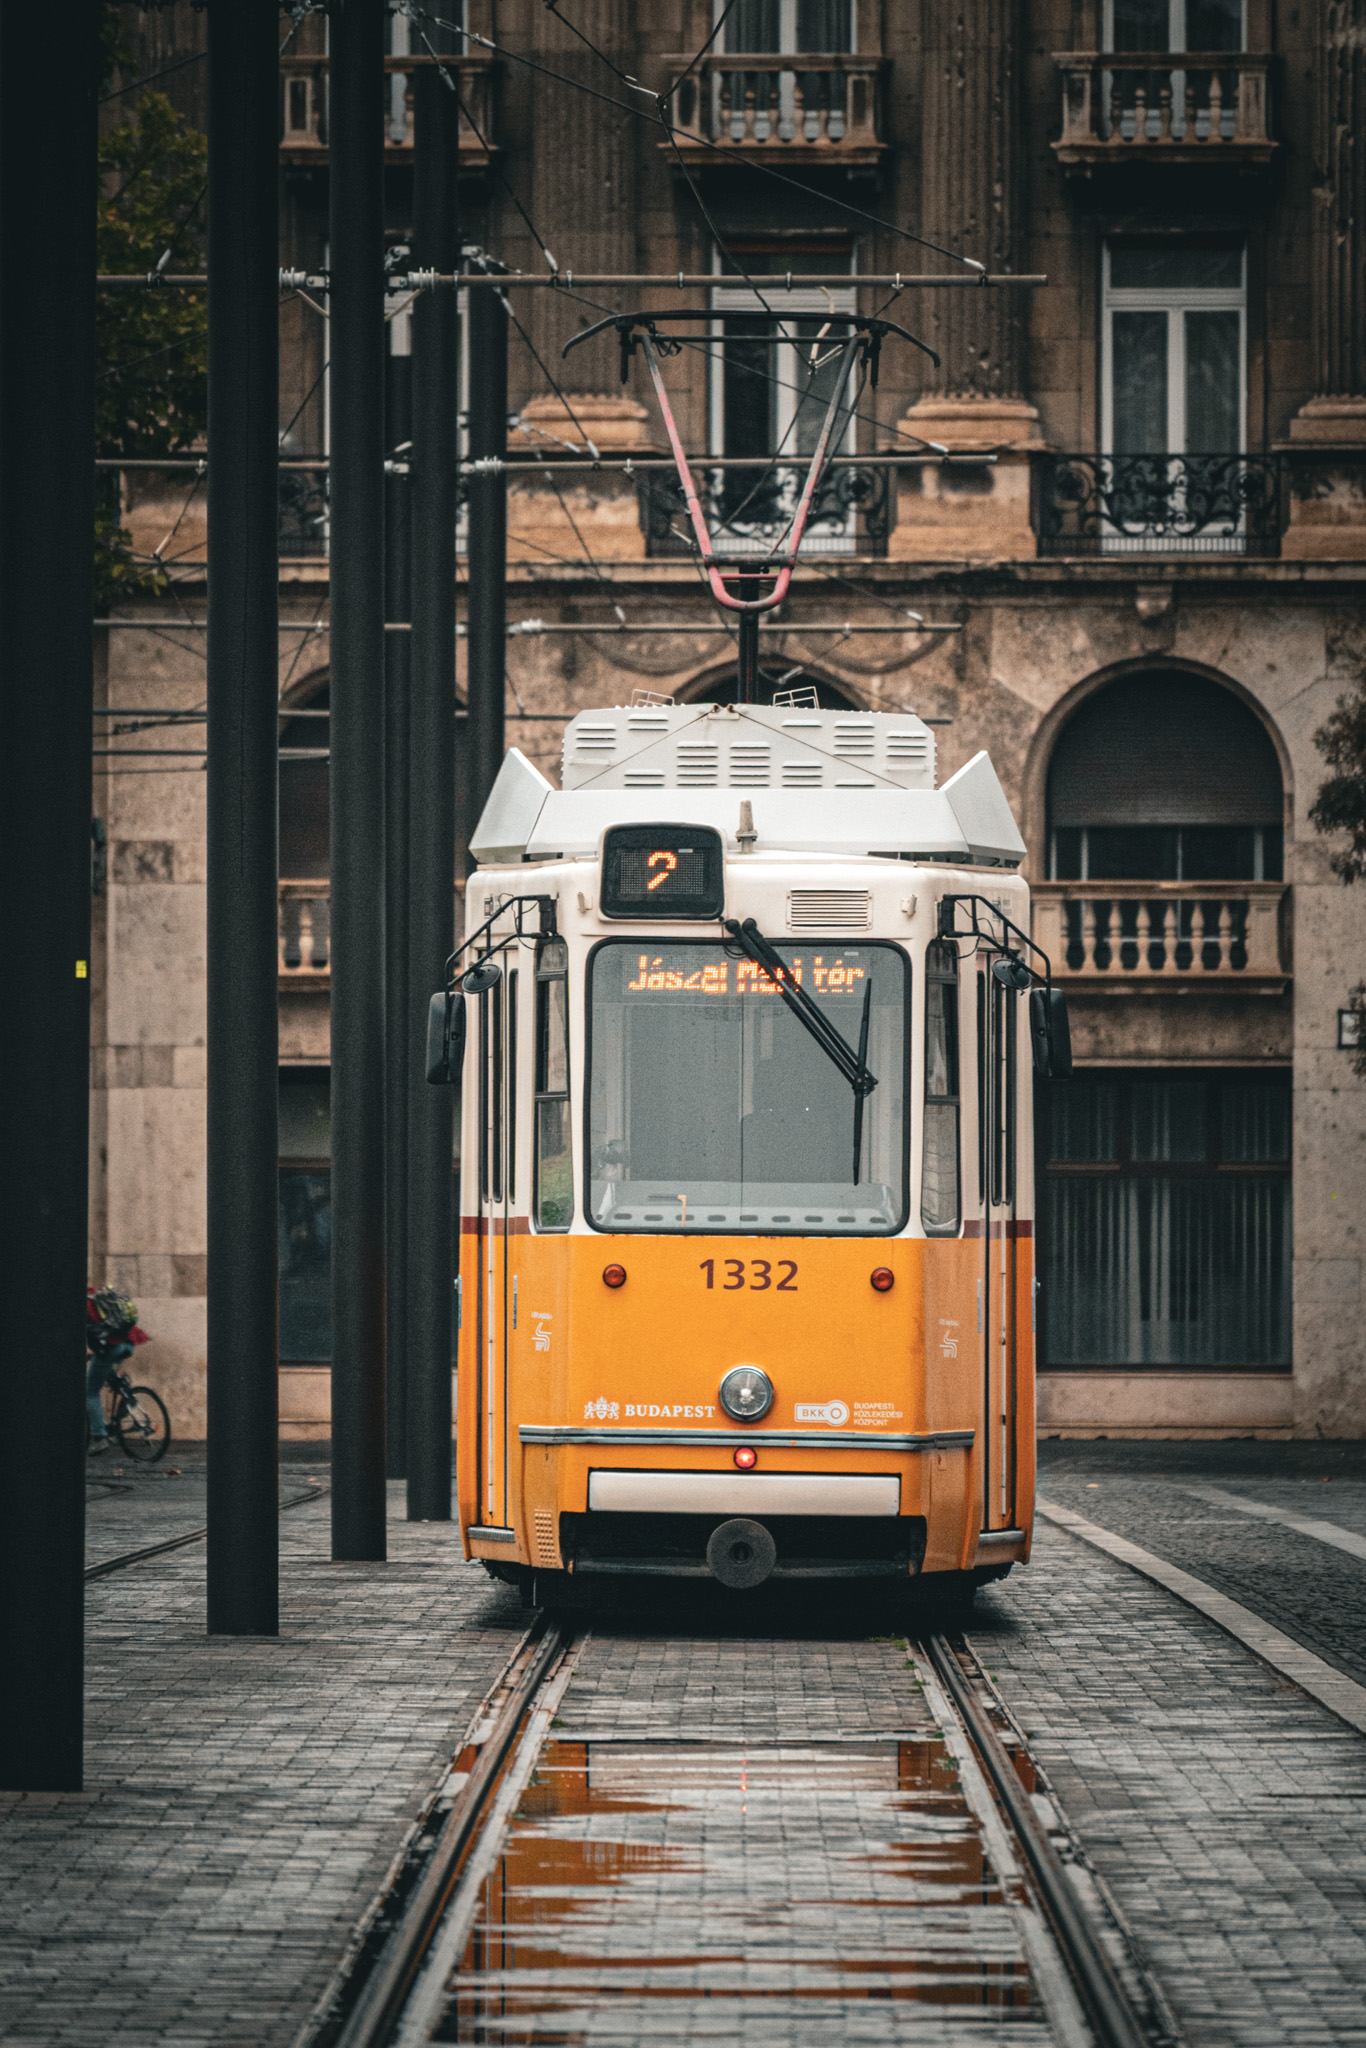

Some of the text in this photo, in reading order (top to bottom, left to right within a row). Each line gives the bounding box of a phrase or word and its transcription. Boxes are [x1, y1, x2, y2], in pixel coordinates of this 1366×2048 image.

[647, 850, 678, 890] 2
[699, 1258, 799, 1292] 1332
[625, 1404, 715, 1418] BUDAPEST
[853, 1402, 895, 1410] BUDAPESTI
[802, 1408, 825, 1417] BKK
[853, 1418, 889, 1426] KÖZPONT
